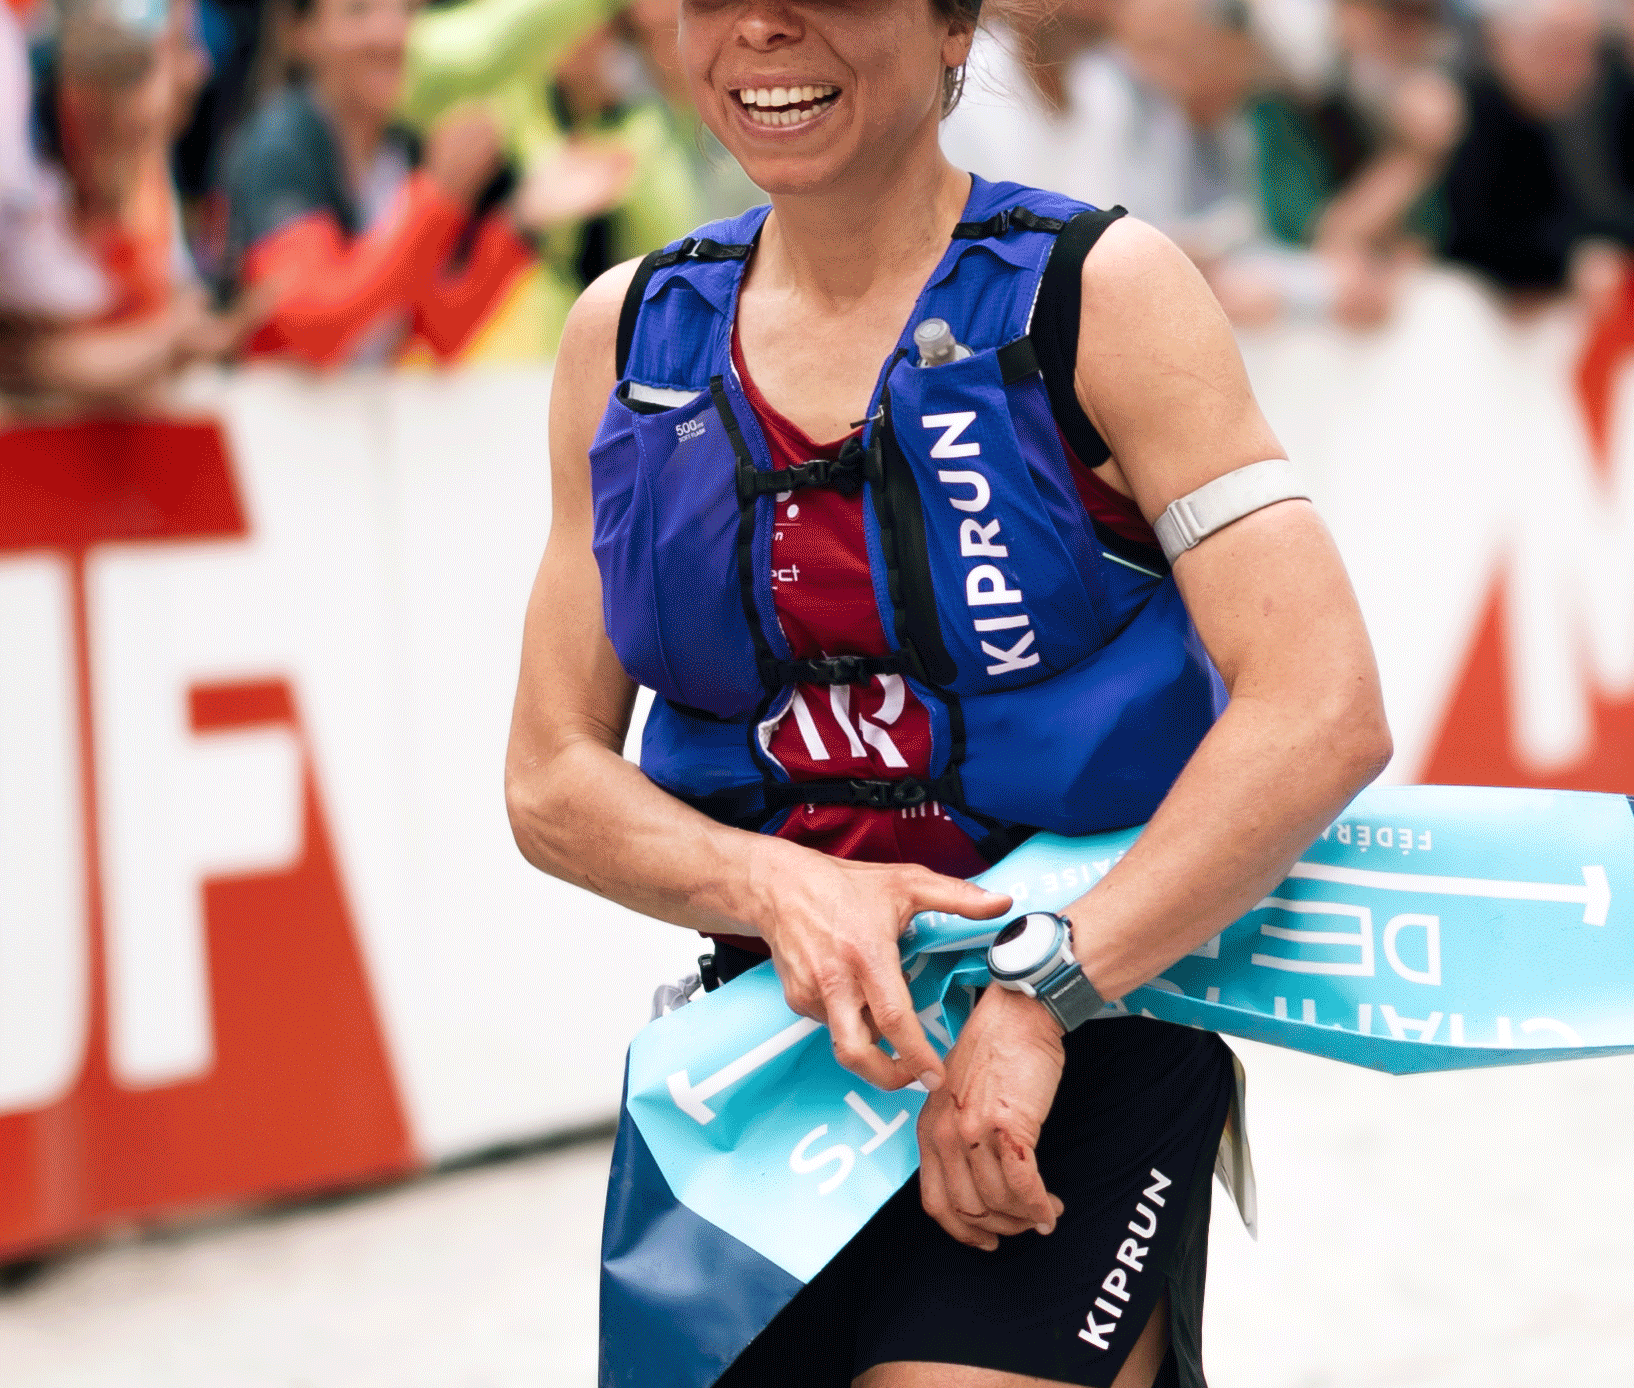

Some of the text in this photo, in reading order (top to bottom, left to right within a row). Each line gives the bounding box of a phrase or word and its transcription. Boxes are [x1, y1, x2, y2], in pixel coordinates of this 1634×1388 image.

[921, 410, 1041, 676] KIPRUN
[1251, 897, 1442, 986] DE
[1078, 1167, 1172, 1351] KIPRUN
